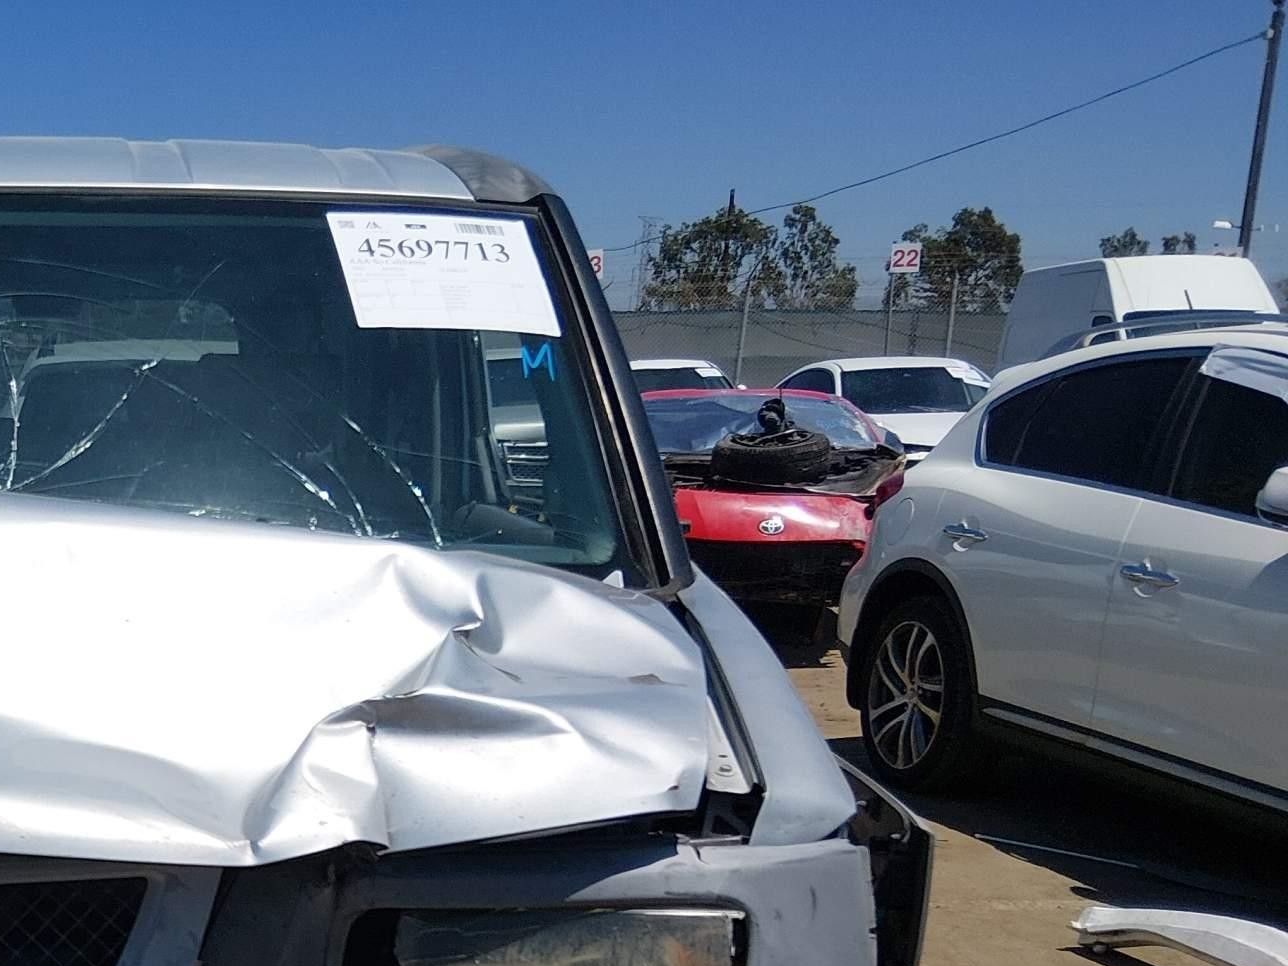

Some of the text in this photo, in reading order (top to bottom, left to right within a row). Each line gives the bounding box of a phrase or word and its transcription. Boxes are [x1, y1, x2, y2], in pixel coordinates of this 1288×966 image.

[358, 238, 510, 263] 45697713
[892, 249, 919, 268] 22
[590, 255, 602, 274] 3
[520, 342, 555, 381] M
